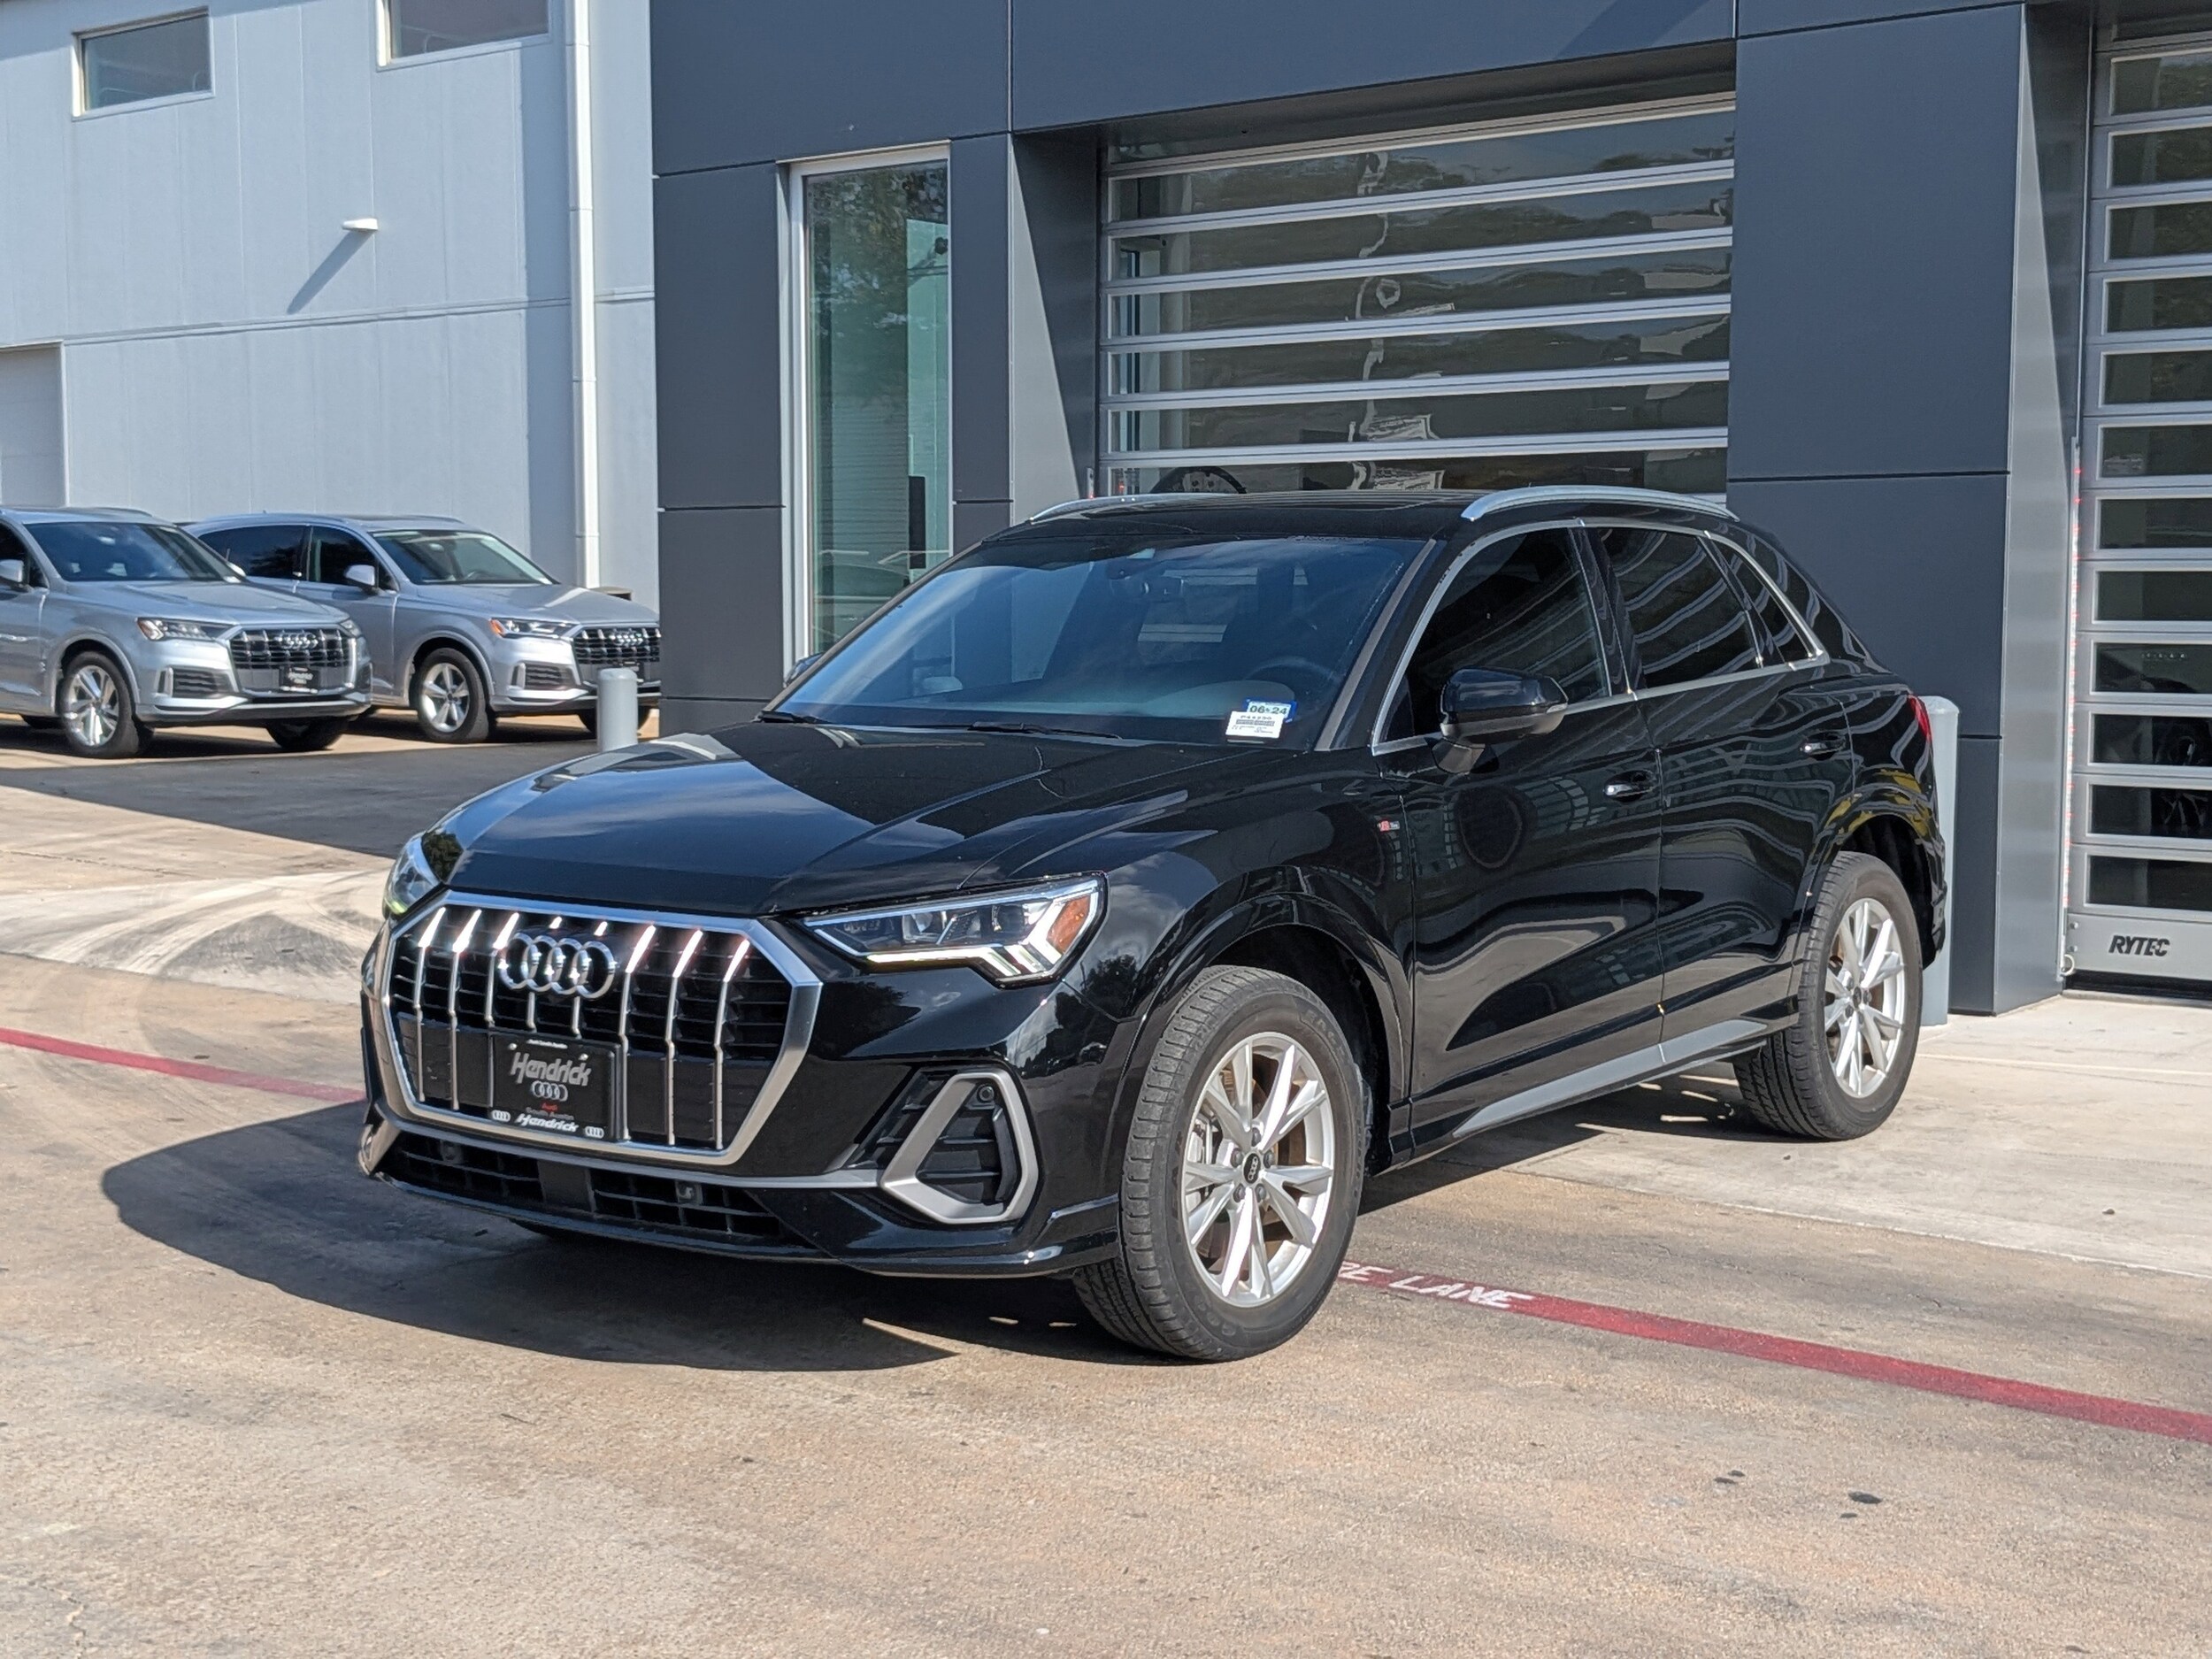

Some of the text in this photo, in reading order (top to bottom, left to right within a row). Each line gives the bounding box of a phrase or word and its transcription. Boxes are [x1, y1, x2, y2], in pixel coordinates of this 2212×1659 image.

[2108, 935, 2170, 956] RYTEC
[510, 1052, 592, 1087] Hendrick
[515, 1113, 579, 1133] Hendrick
[1388, 1275, 1534, 1309] LANE
